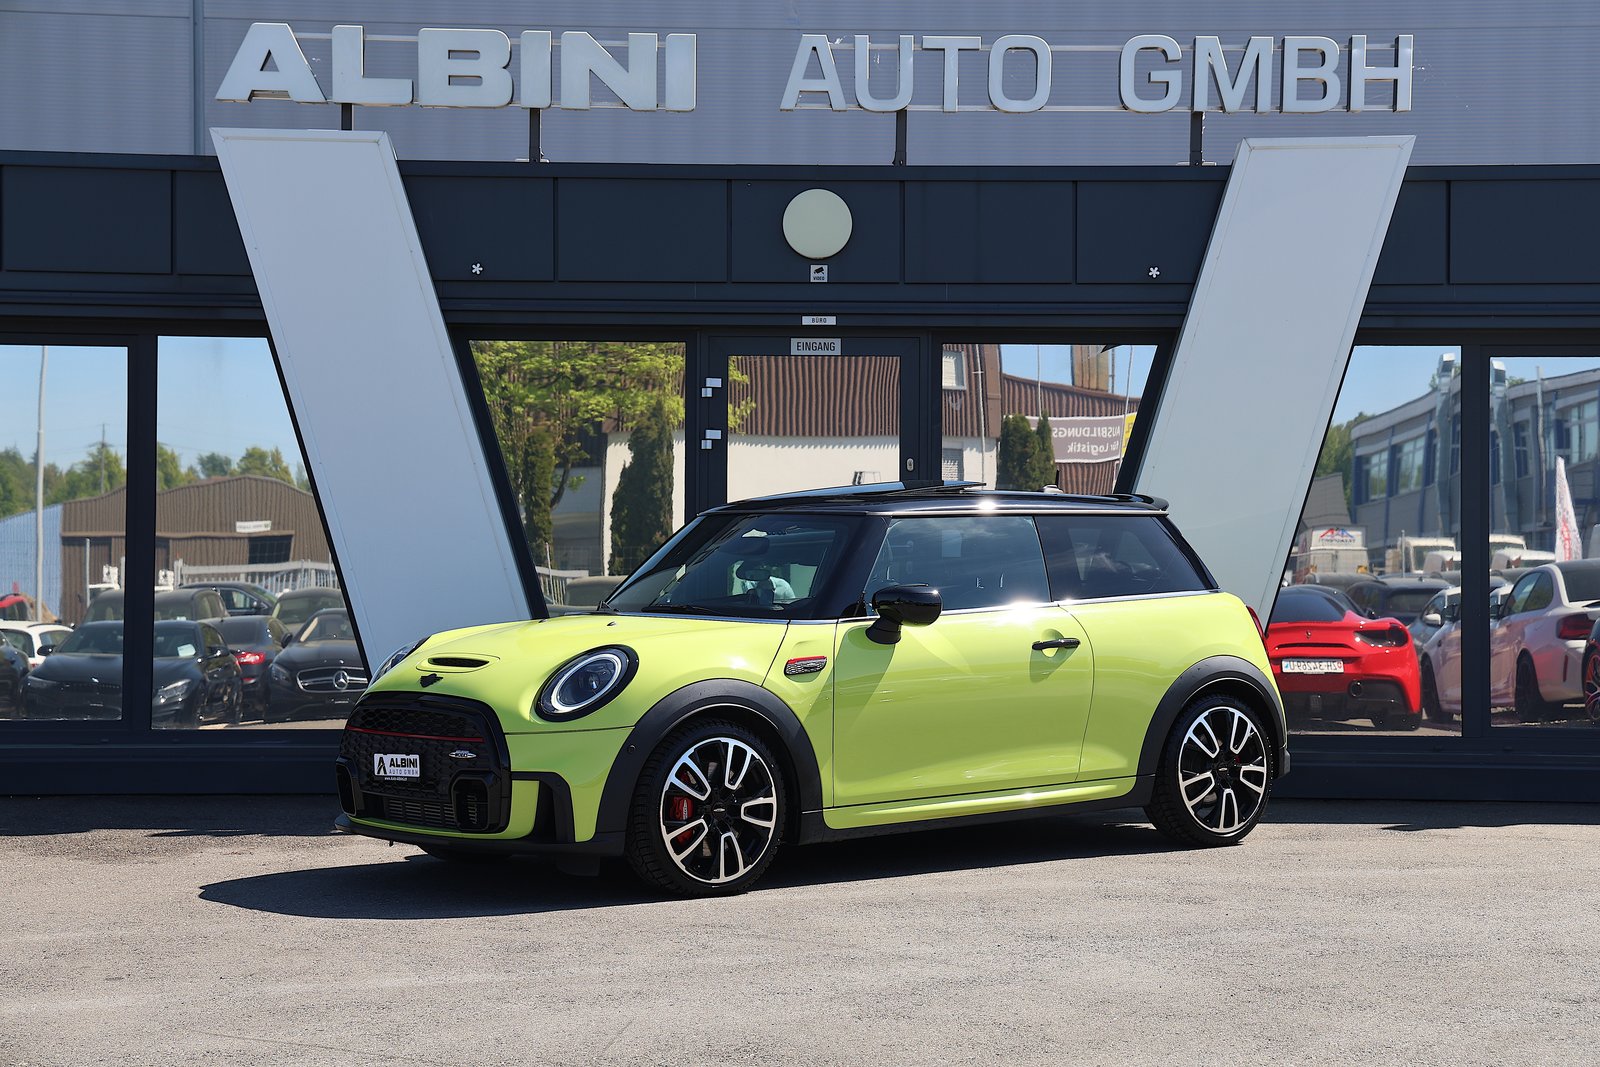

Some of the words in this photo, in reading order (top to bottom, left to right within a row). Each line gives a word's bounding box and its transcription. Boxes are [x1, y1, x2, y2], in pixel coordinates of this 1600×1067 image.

[214, 22, 697, 112] ALBINI
[779, 34, 1053, 114] AUTO
[1119, 34, 1414, 114] GMBH
[796, 341, 836, 352] EINGANG
[389, 758, 418, 768] ALBINI
